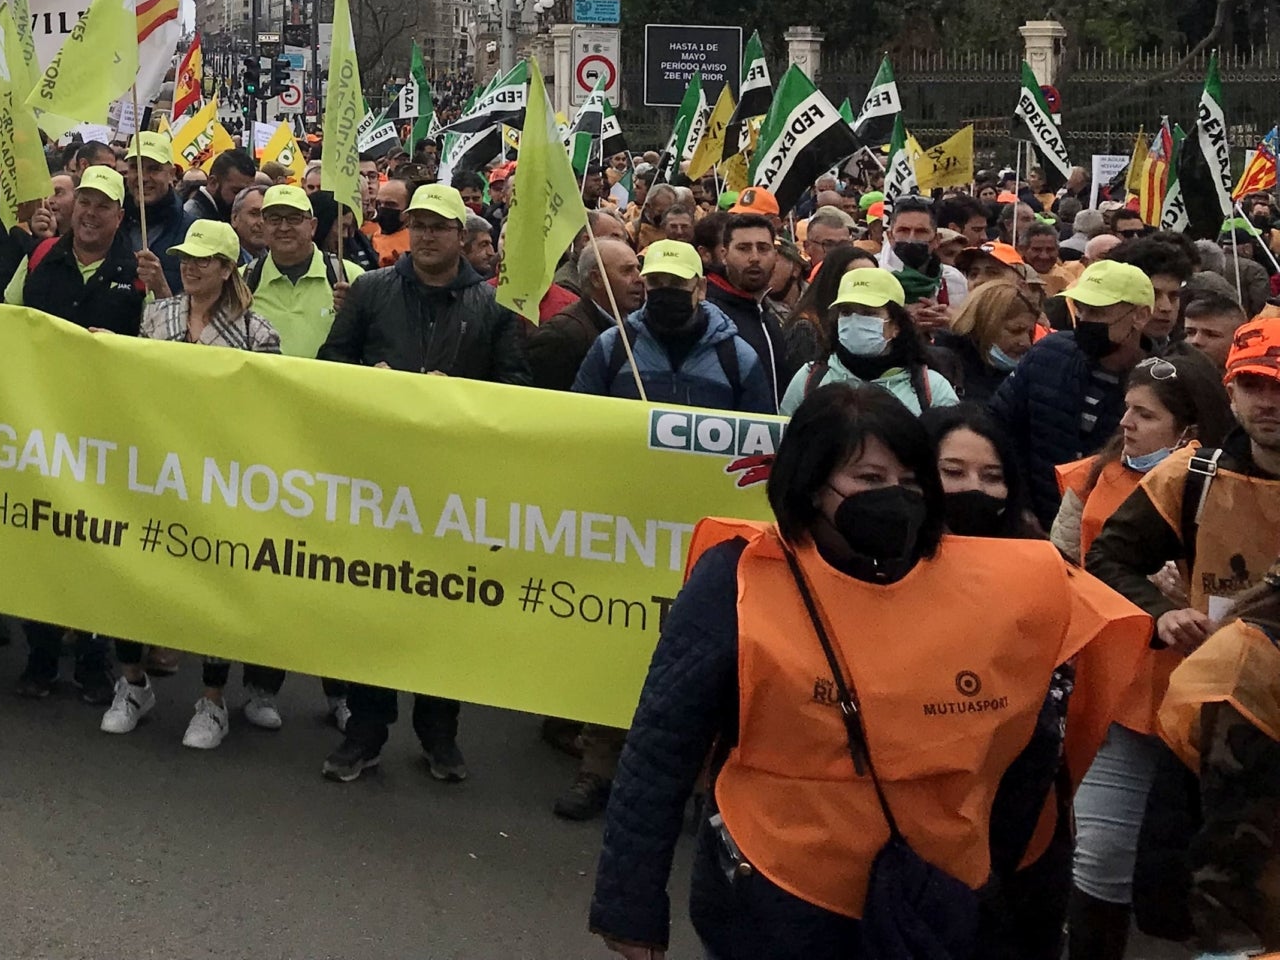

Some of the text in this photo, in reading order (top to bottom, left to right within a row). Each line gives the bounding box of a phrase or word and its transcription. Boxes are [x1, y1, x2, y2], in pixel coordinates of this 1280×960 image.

[669, 43, 718, 51] HASTA 1 DE
[681, 52, 707, 61] MAYO
[701, 63, 727, 72] AVISO
[664, 71, 724, 81] ZBE INRIOR
[656, 411, 776, 456] COA
[128, 445, 188, 501] LA
[201, 458, 423, 535] NOSTRA
[434, 493, 696, 573] ALIMENT
[519, 577, 678, 632] #SomT
[923, 696, 1009, 716] MUTUASPORT
